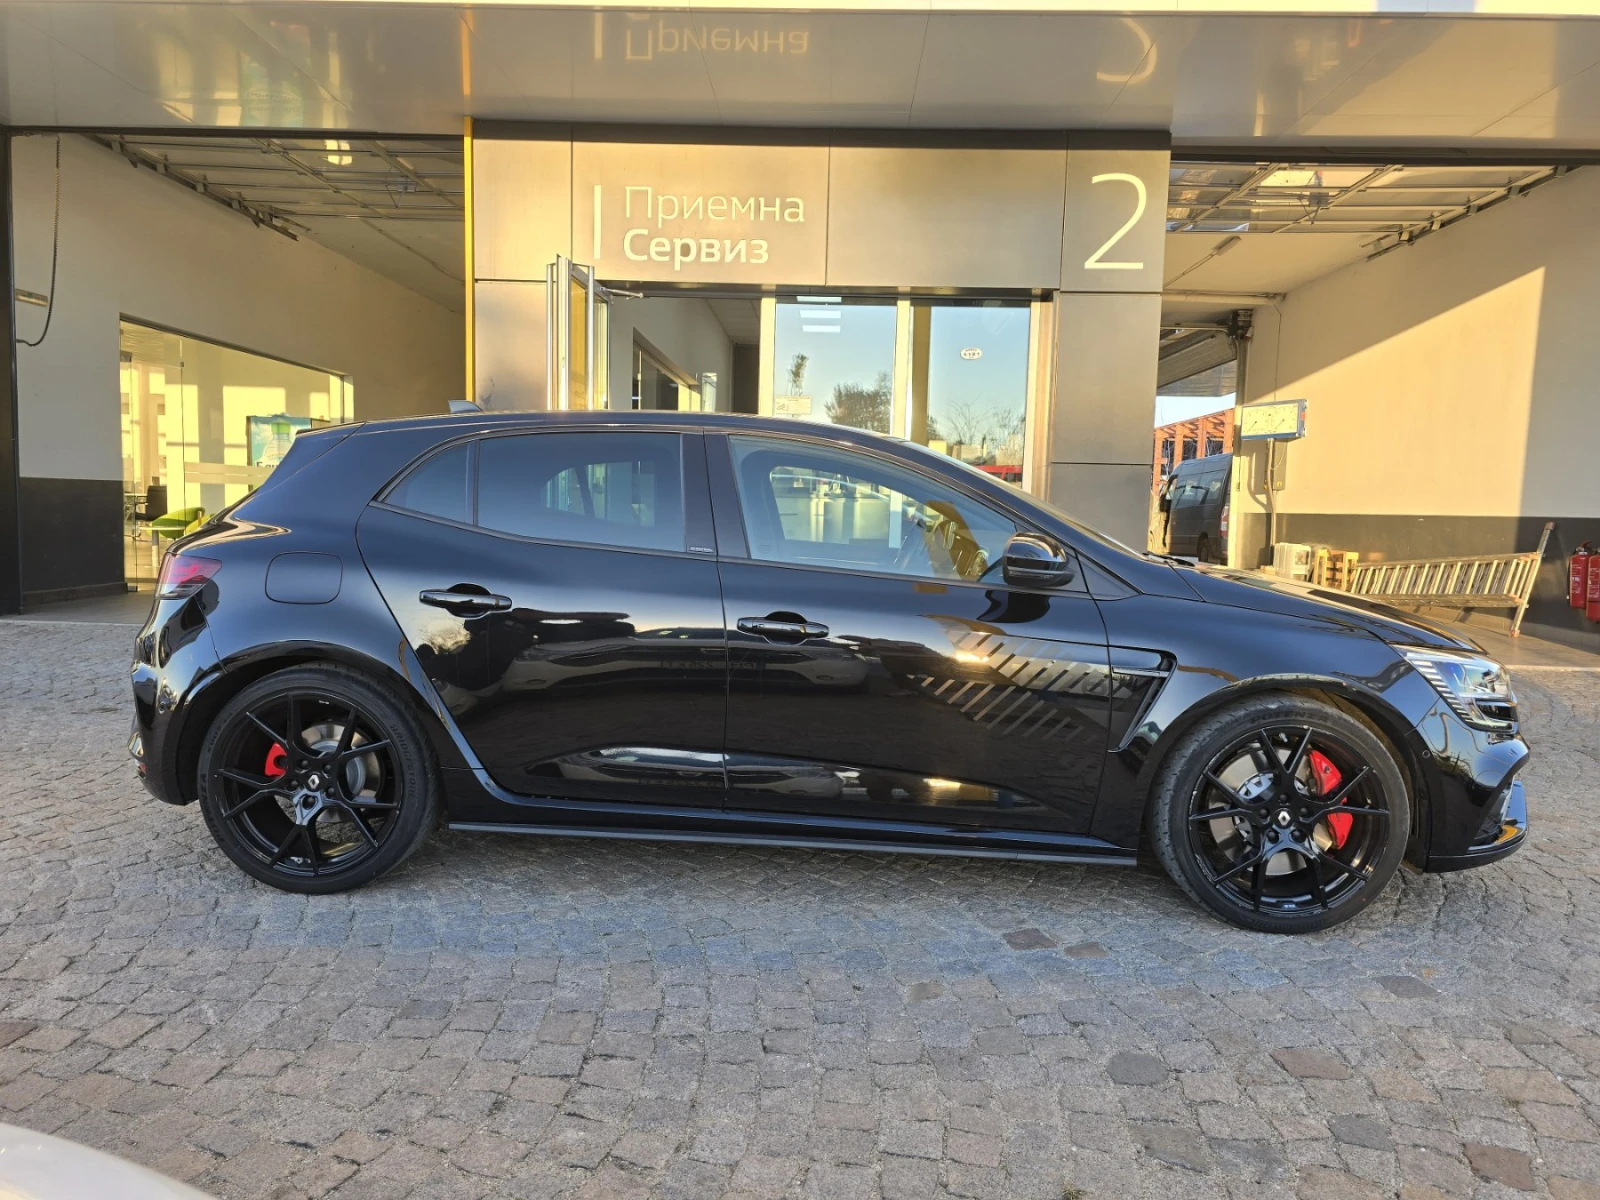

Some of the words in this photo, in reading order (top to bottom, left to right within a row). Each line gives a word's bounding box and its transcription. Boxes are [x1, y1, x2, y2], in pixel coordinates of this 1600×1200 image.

[624, 185, 806, 229] Приемна
[1084, 172, 1147, 269] 2
[623, 228, 770, 271] Сервиз
